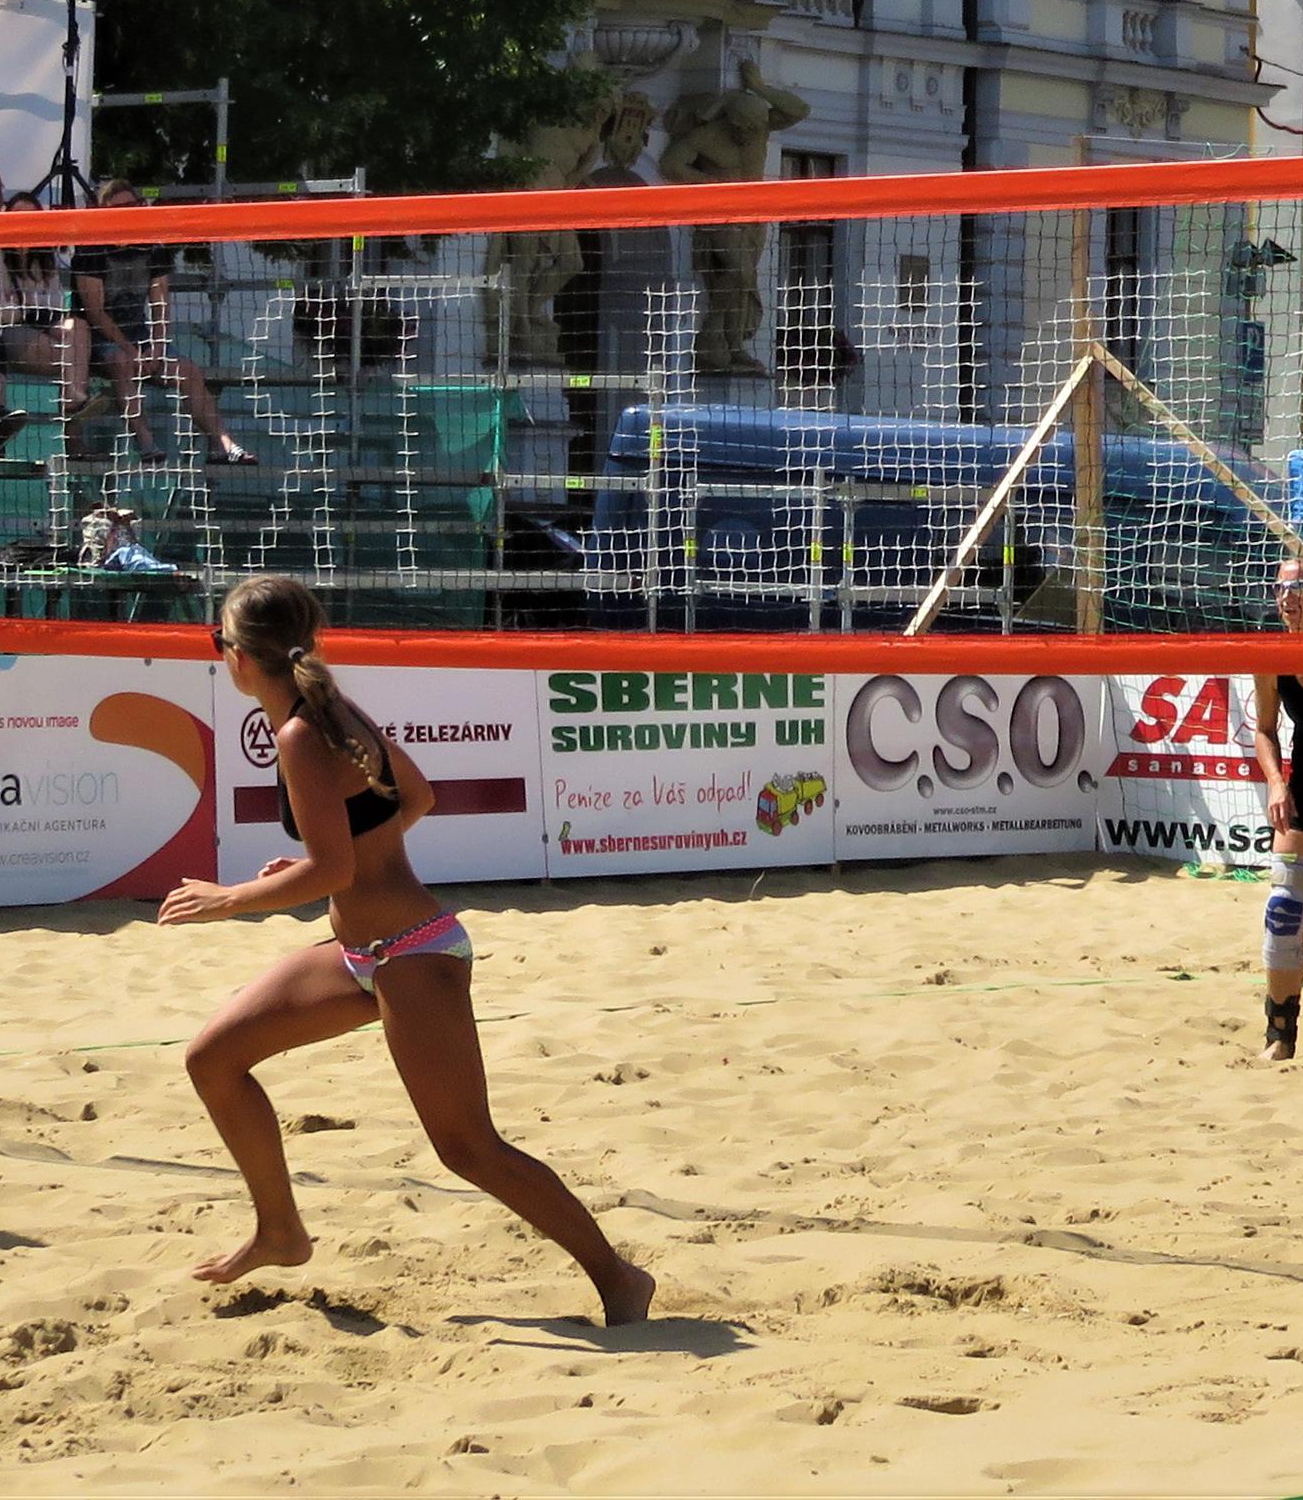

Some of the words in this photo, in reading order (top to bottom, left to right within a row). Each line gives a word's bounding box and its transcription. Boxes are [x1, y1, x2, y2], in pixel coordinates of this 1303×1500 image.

[402, 721, 512, 743] ŽELEZÁRNY
[551, 722, 756, 752] SUROVINY
[775, 719, 825, 746] UH
[1128, 758, 1251, 777] sanace
[623, 790, 644, 810] za
[45, 819, 106, 831] AGENTURA
[924, 821, 985, 834] METALWORKS
